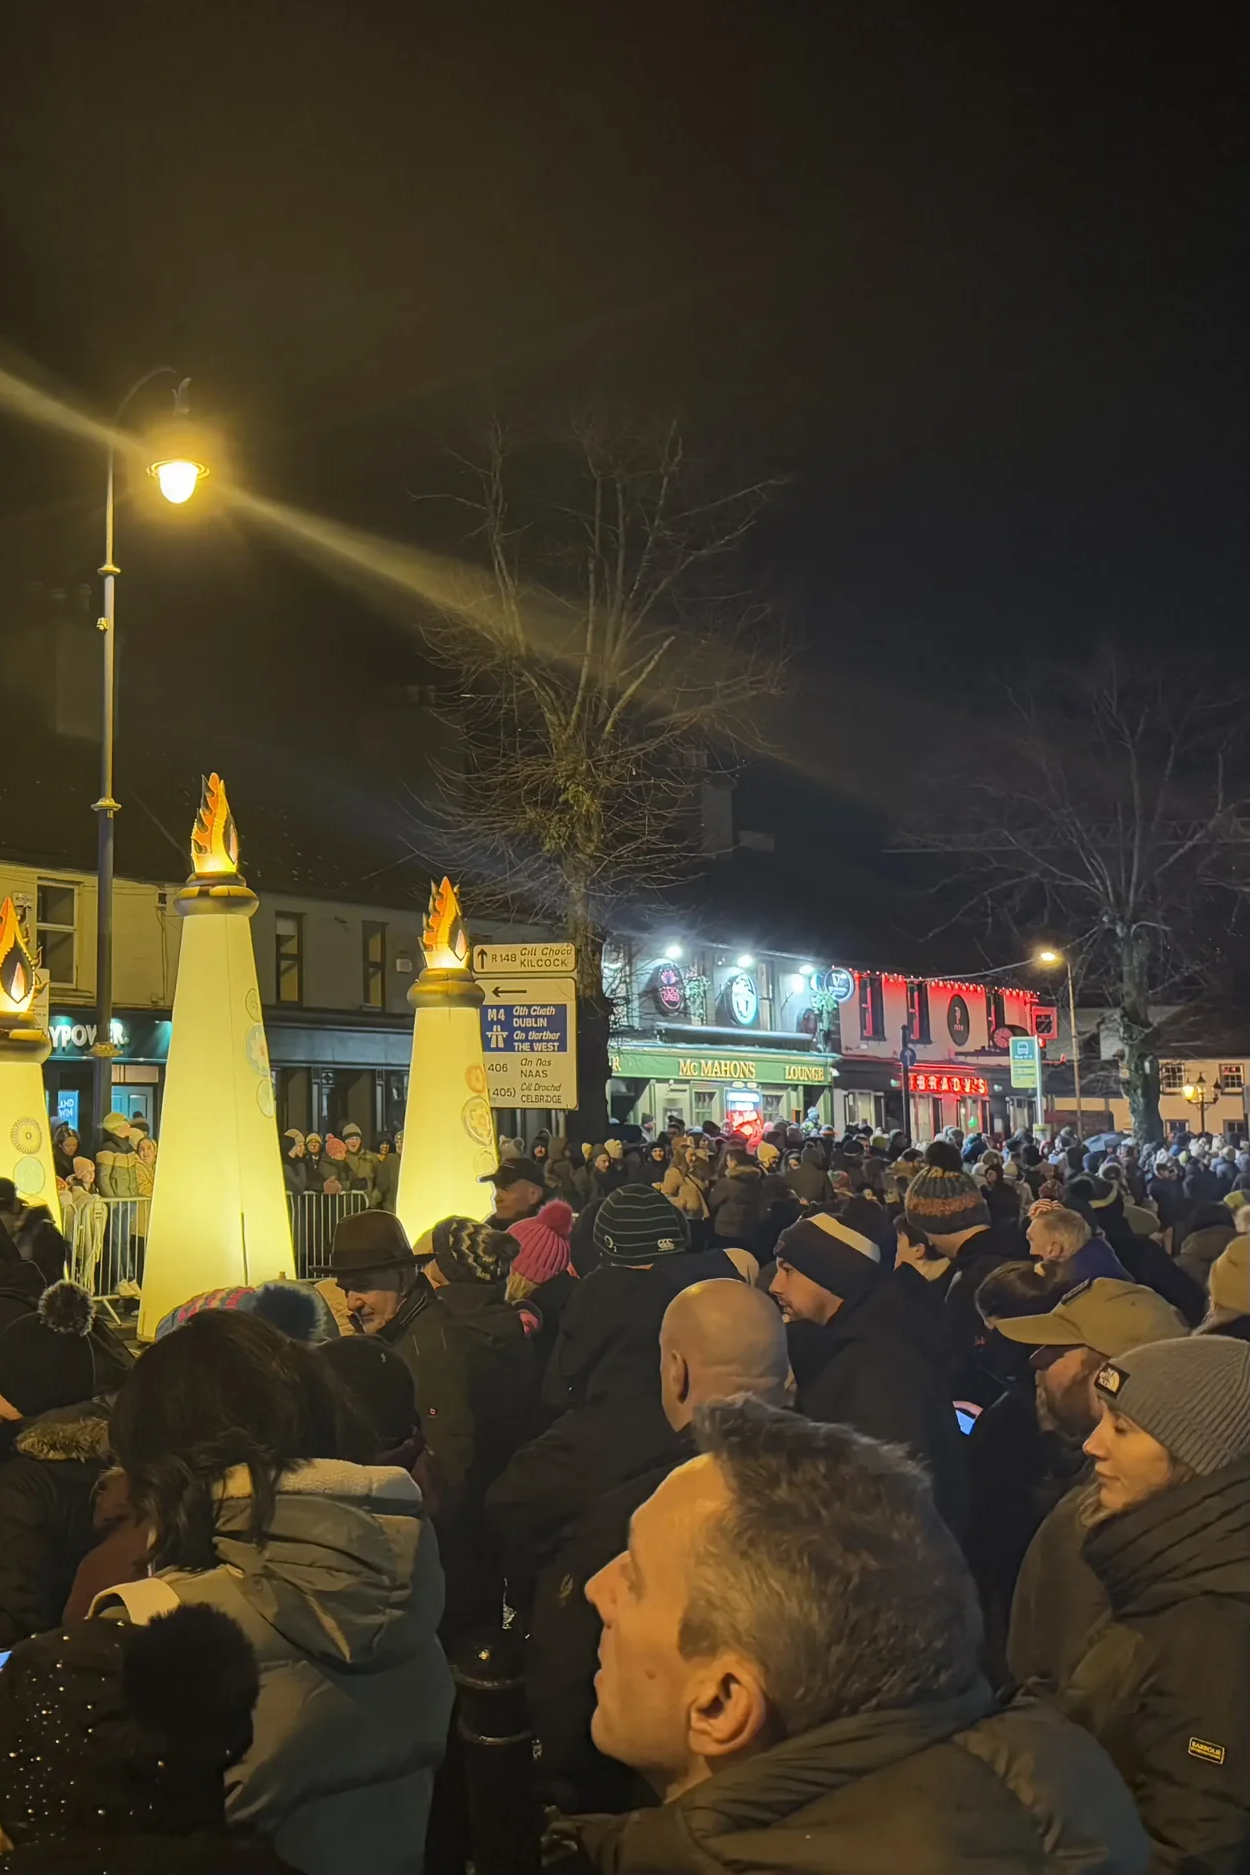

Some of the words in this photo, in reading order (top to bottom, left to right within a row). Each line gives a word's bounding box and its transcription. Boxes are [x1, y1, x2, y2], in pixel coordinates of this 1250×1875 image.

[520, 947, 537, 956] Cill
[520, 958, 568, 968] KILCOCK
[487, 1008, 505, 1021] M4
[513, 1017, 547, 1027] DUBLIN
[513, 1042, 531, 1052] THE
[533, 1042, 560, 1052] WEST
[520, 1069, 548, 1079] NAAS
[700, 1059, 756, 1080] MAHONS
[784, 1065, 825, 1081] LOUNGE
[916, 1074, 986, 1095] BRADY'S
[520, 1094, 562, 1104] CELBRIDGE
